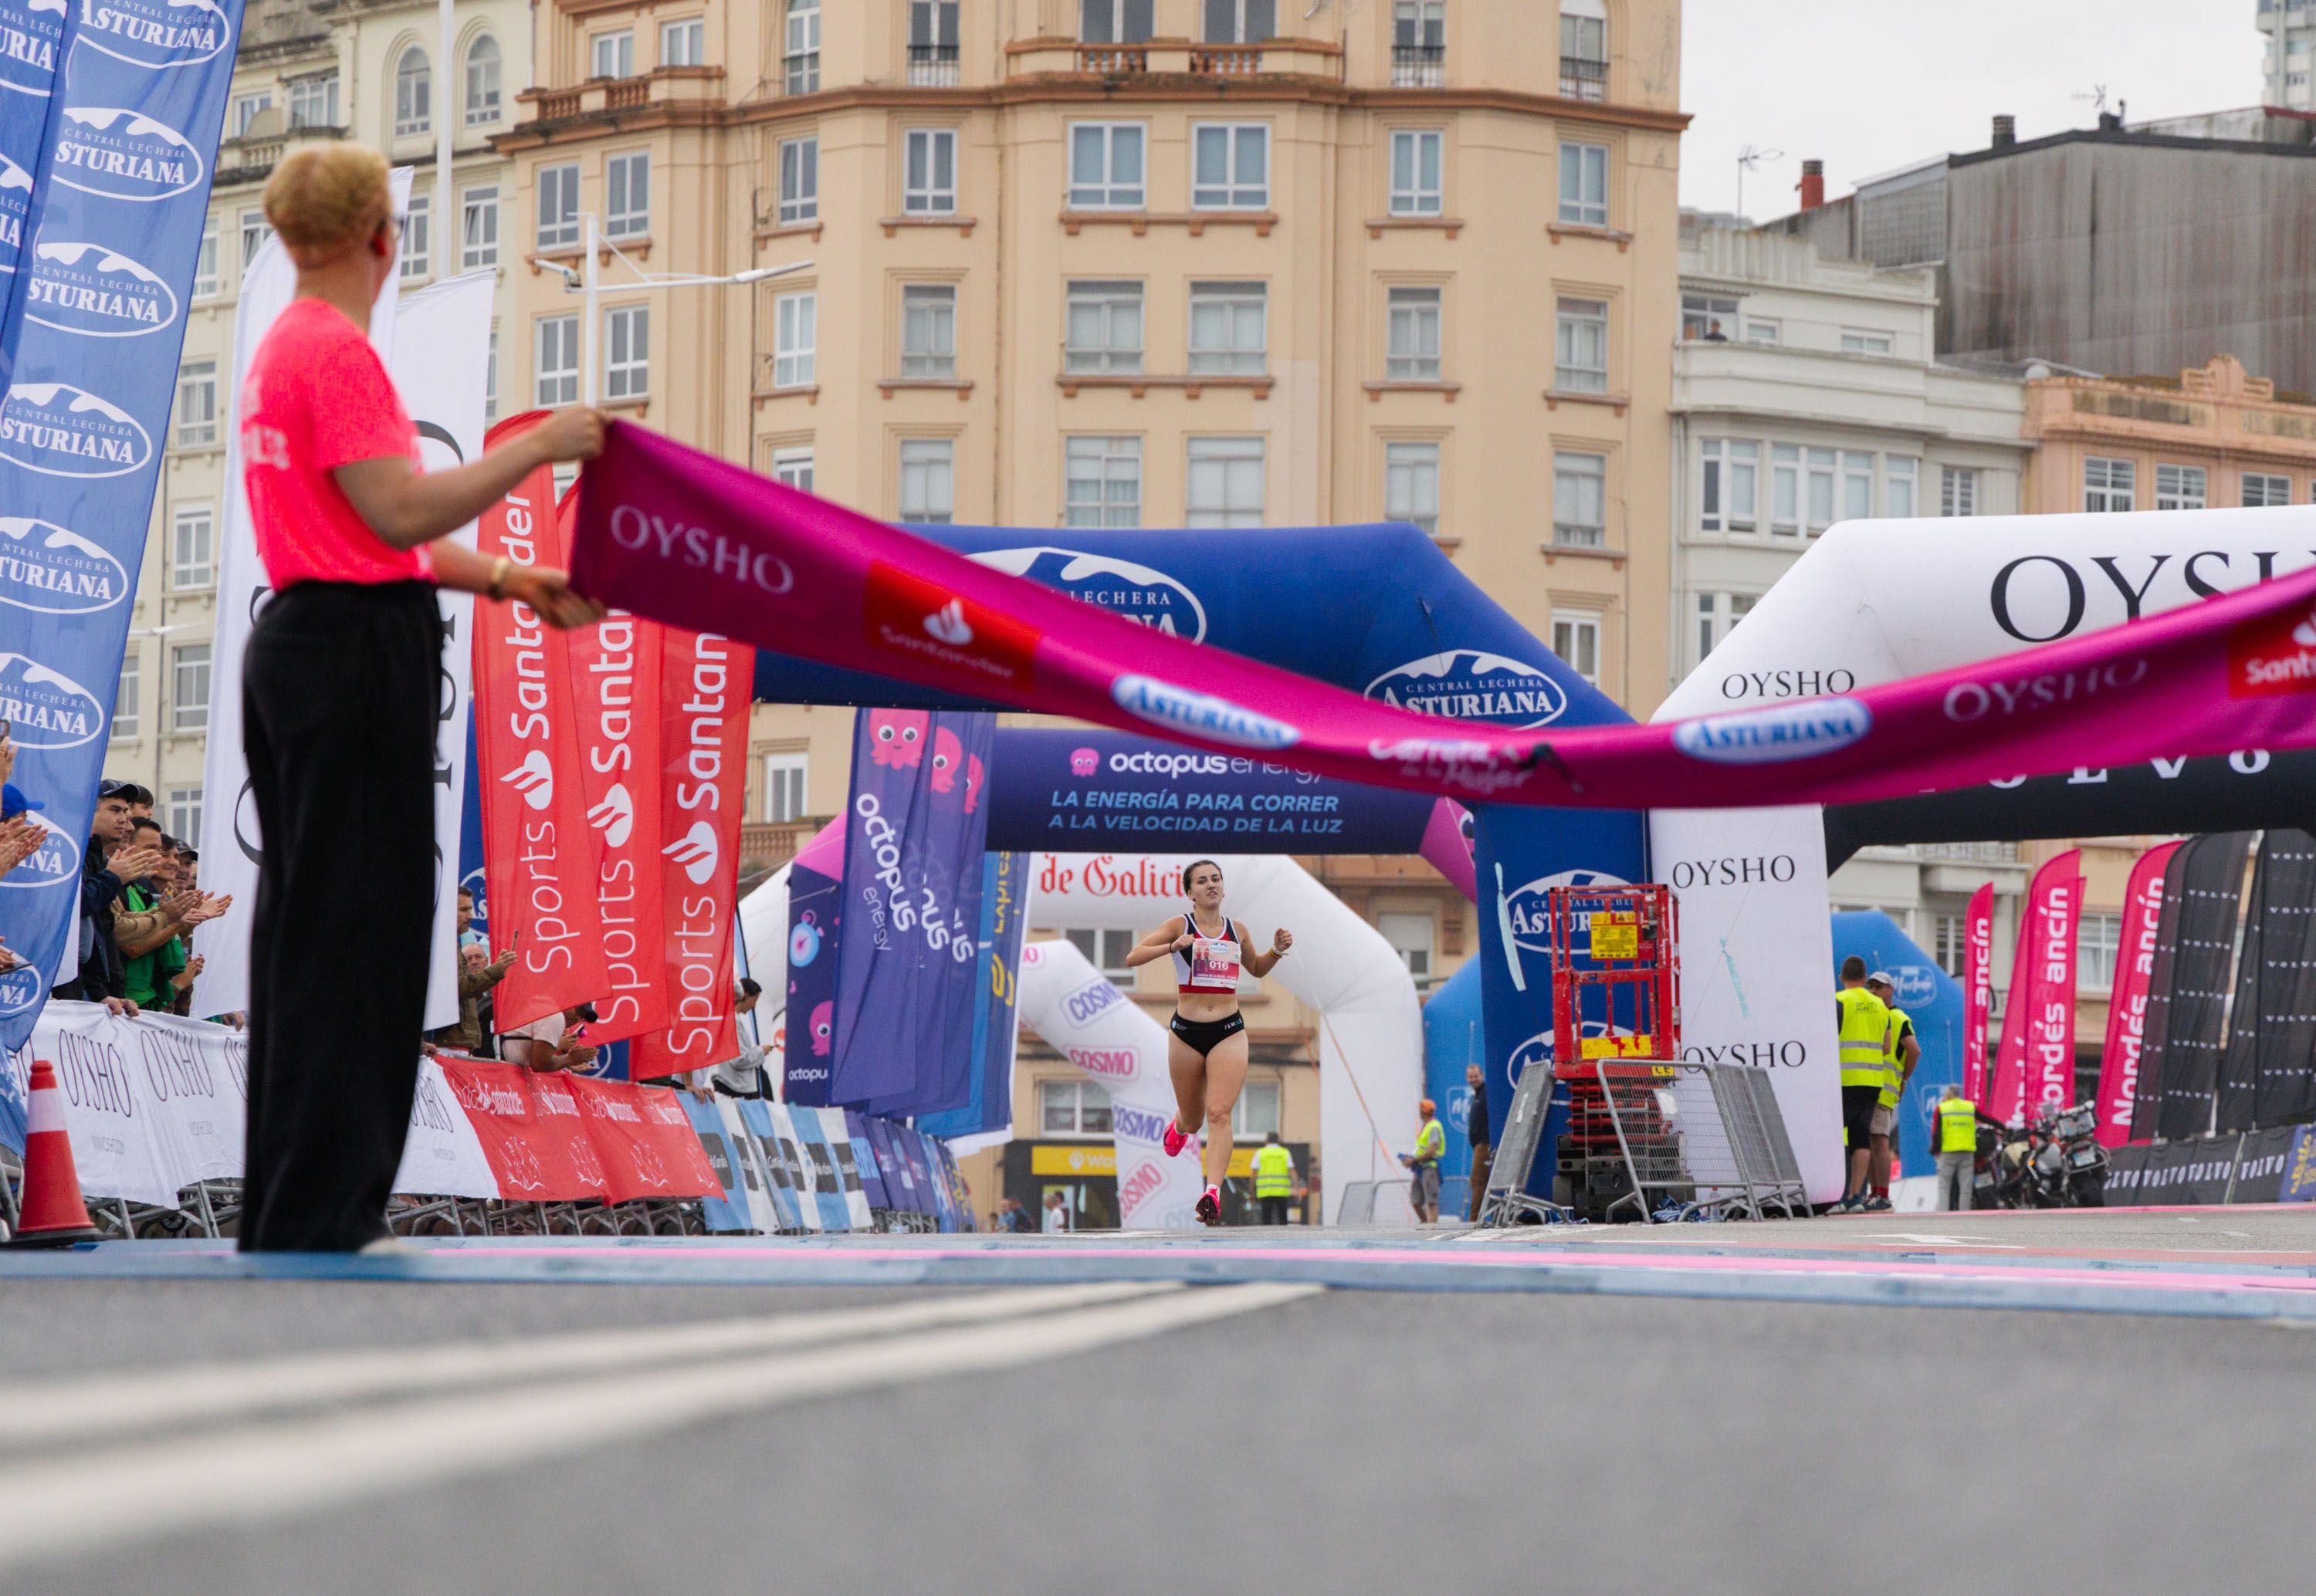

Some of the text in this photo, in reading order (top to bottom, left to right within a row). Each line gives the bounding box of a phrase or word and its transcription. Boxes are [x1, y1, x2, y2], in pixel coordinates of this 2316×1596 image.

[64, 127, 185, 158] CENTRAL LECHERA
[33, 264, 158, 296] CENTRAL LECHERA
[6, 404, 133, 437] CENTRAL LECHERA
[47, 554, 110, 573] LECHERA
[611, 504, 794, 594] OYSHO
[1070, 591, 1171, 605] LECHERA
[500, 492, 550, 740] Santader
[24, 688, 86, 708] LECHERA
[1406, 678, 1543, 693] CENTRAL LECHERA
[1722, 668, 1855, 698] OYSHO
[1943, 658, 2147, 722] OYSHO
[1383, 686, 1554, 718] ASTURIANA
[1109, 751, 1227, 779] octopus
[1051, 789, 1339, 812] LA ENERGÍA PARA CORRER
[1048, 813, 1344, 834] A LA VELOCIDAD DE LA LUZ
[856, 793, 917, 932] octopus
[1040, 854, 1073, 894] de
[1672, 854, 1796, 889] OYSHO
[520, 820, 581, 973] Sports
[2189, 889, 2238, 901] VOLVO
[863, 887, 892, 951] energy
[593, 859, 651, 1025] Sports
[2183, 938, 2231, 950] VOLVO
[668, 896, 726, 1054] Sports
[1209, 961, 1229, 970] 016
[1972, 918, 1989, 1006] ancín
[2034, 887, 2068, 1106] ordés ancín
[2111, 995, 2148, 1127] Nordés
[2136, 877, 2165, 976] ancín
[2178, 989, 2223, 999] VOLVO
[2265, 1014, 2316, 1023] VOLVO
[1683, 1040, 1806, 1074] OYSHO
[2173, 1039, 2218, 1050] VOLVO
[59, 1028, 131, 1118] OYSHO
[141, 1028, 214, 1102] OYSHO
[1069, 1049, 1133, 1076] COSMO
[2168, 1089, 2213, 1099] VOLVO
[2143, 1165, 2186, 1188] VOLVO
[2187, 1161, 2231, 1182] VOLVO
[2240, 1154, 2285, 1181] VOLVO
